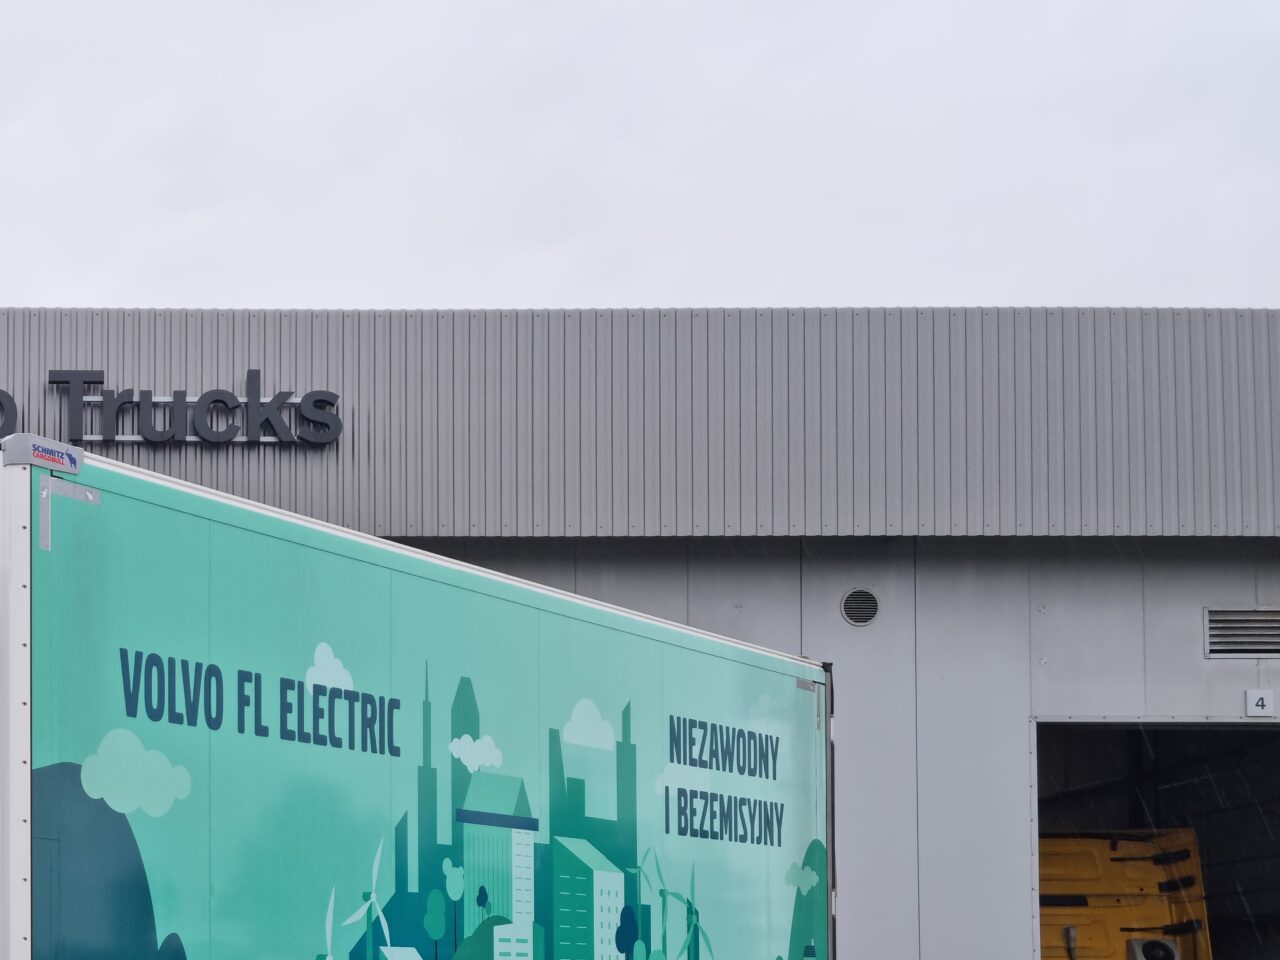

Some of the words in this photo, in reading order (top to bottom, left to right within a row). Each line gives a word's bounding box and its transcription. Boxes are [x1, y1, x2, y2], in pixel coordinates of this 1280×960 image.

[48, 368, 344, 443] Trucks
[32, 444, 65, 459] SCHMITZ
[32, 451, 65, 465] CARGOBULL
[119, 647, 224, 731] VOLVO
[237, 669, 269, 738] FL
[279, 677, 401, 758] ELECTRIC
[1255, 696, 1266, 710] 4
[669, 714, 780, 781] NIEZAWODNY
[664, 785, 670, 835] I
[677, 787, 785, 848] BEZEMISYJNY
